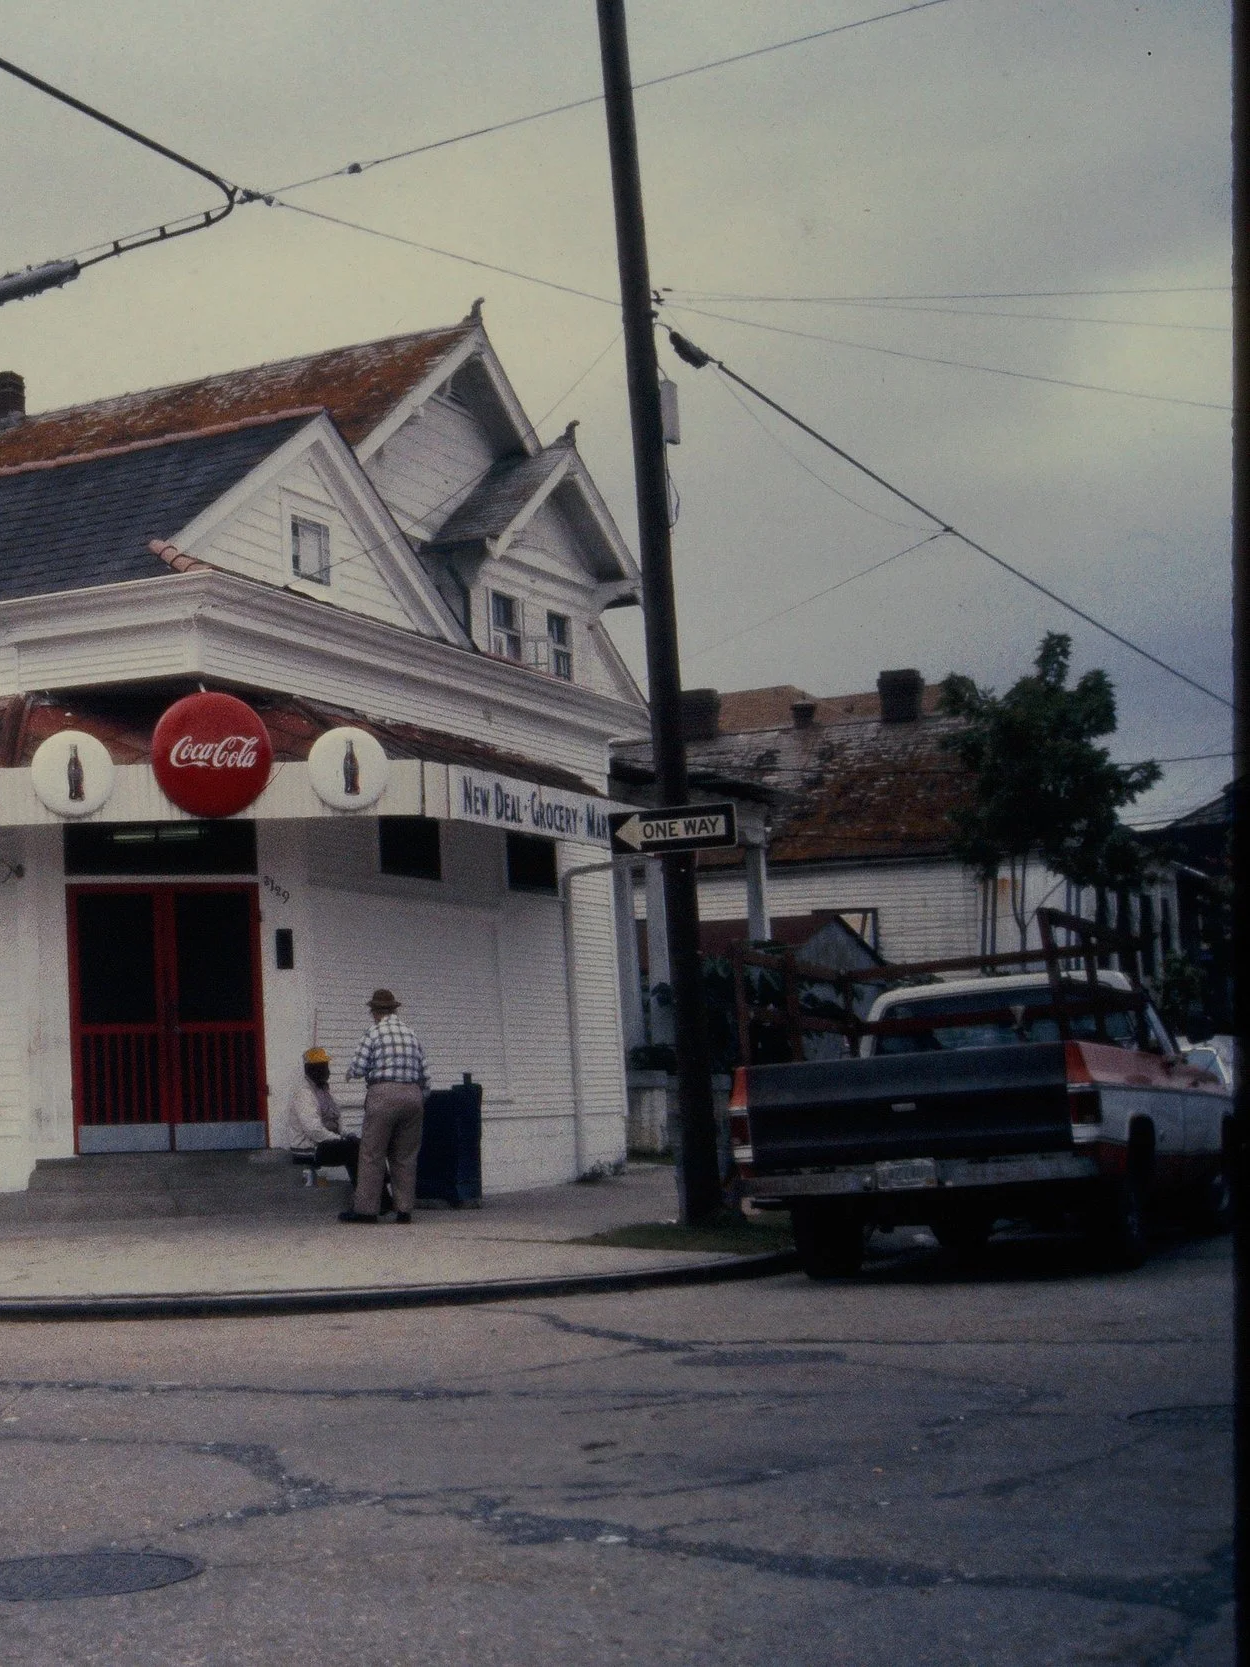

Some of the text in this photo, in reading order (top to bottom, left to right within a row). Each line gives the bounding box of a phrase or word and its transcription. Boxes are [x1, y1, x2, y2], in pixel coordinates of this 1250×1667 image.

[170, 736, 259, 768] Coca-Cola
[643, 816, 720, 839] ONE WAY
